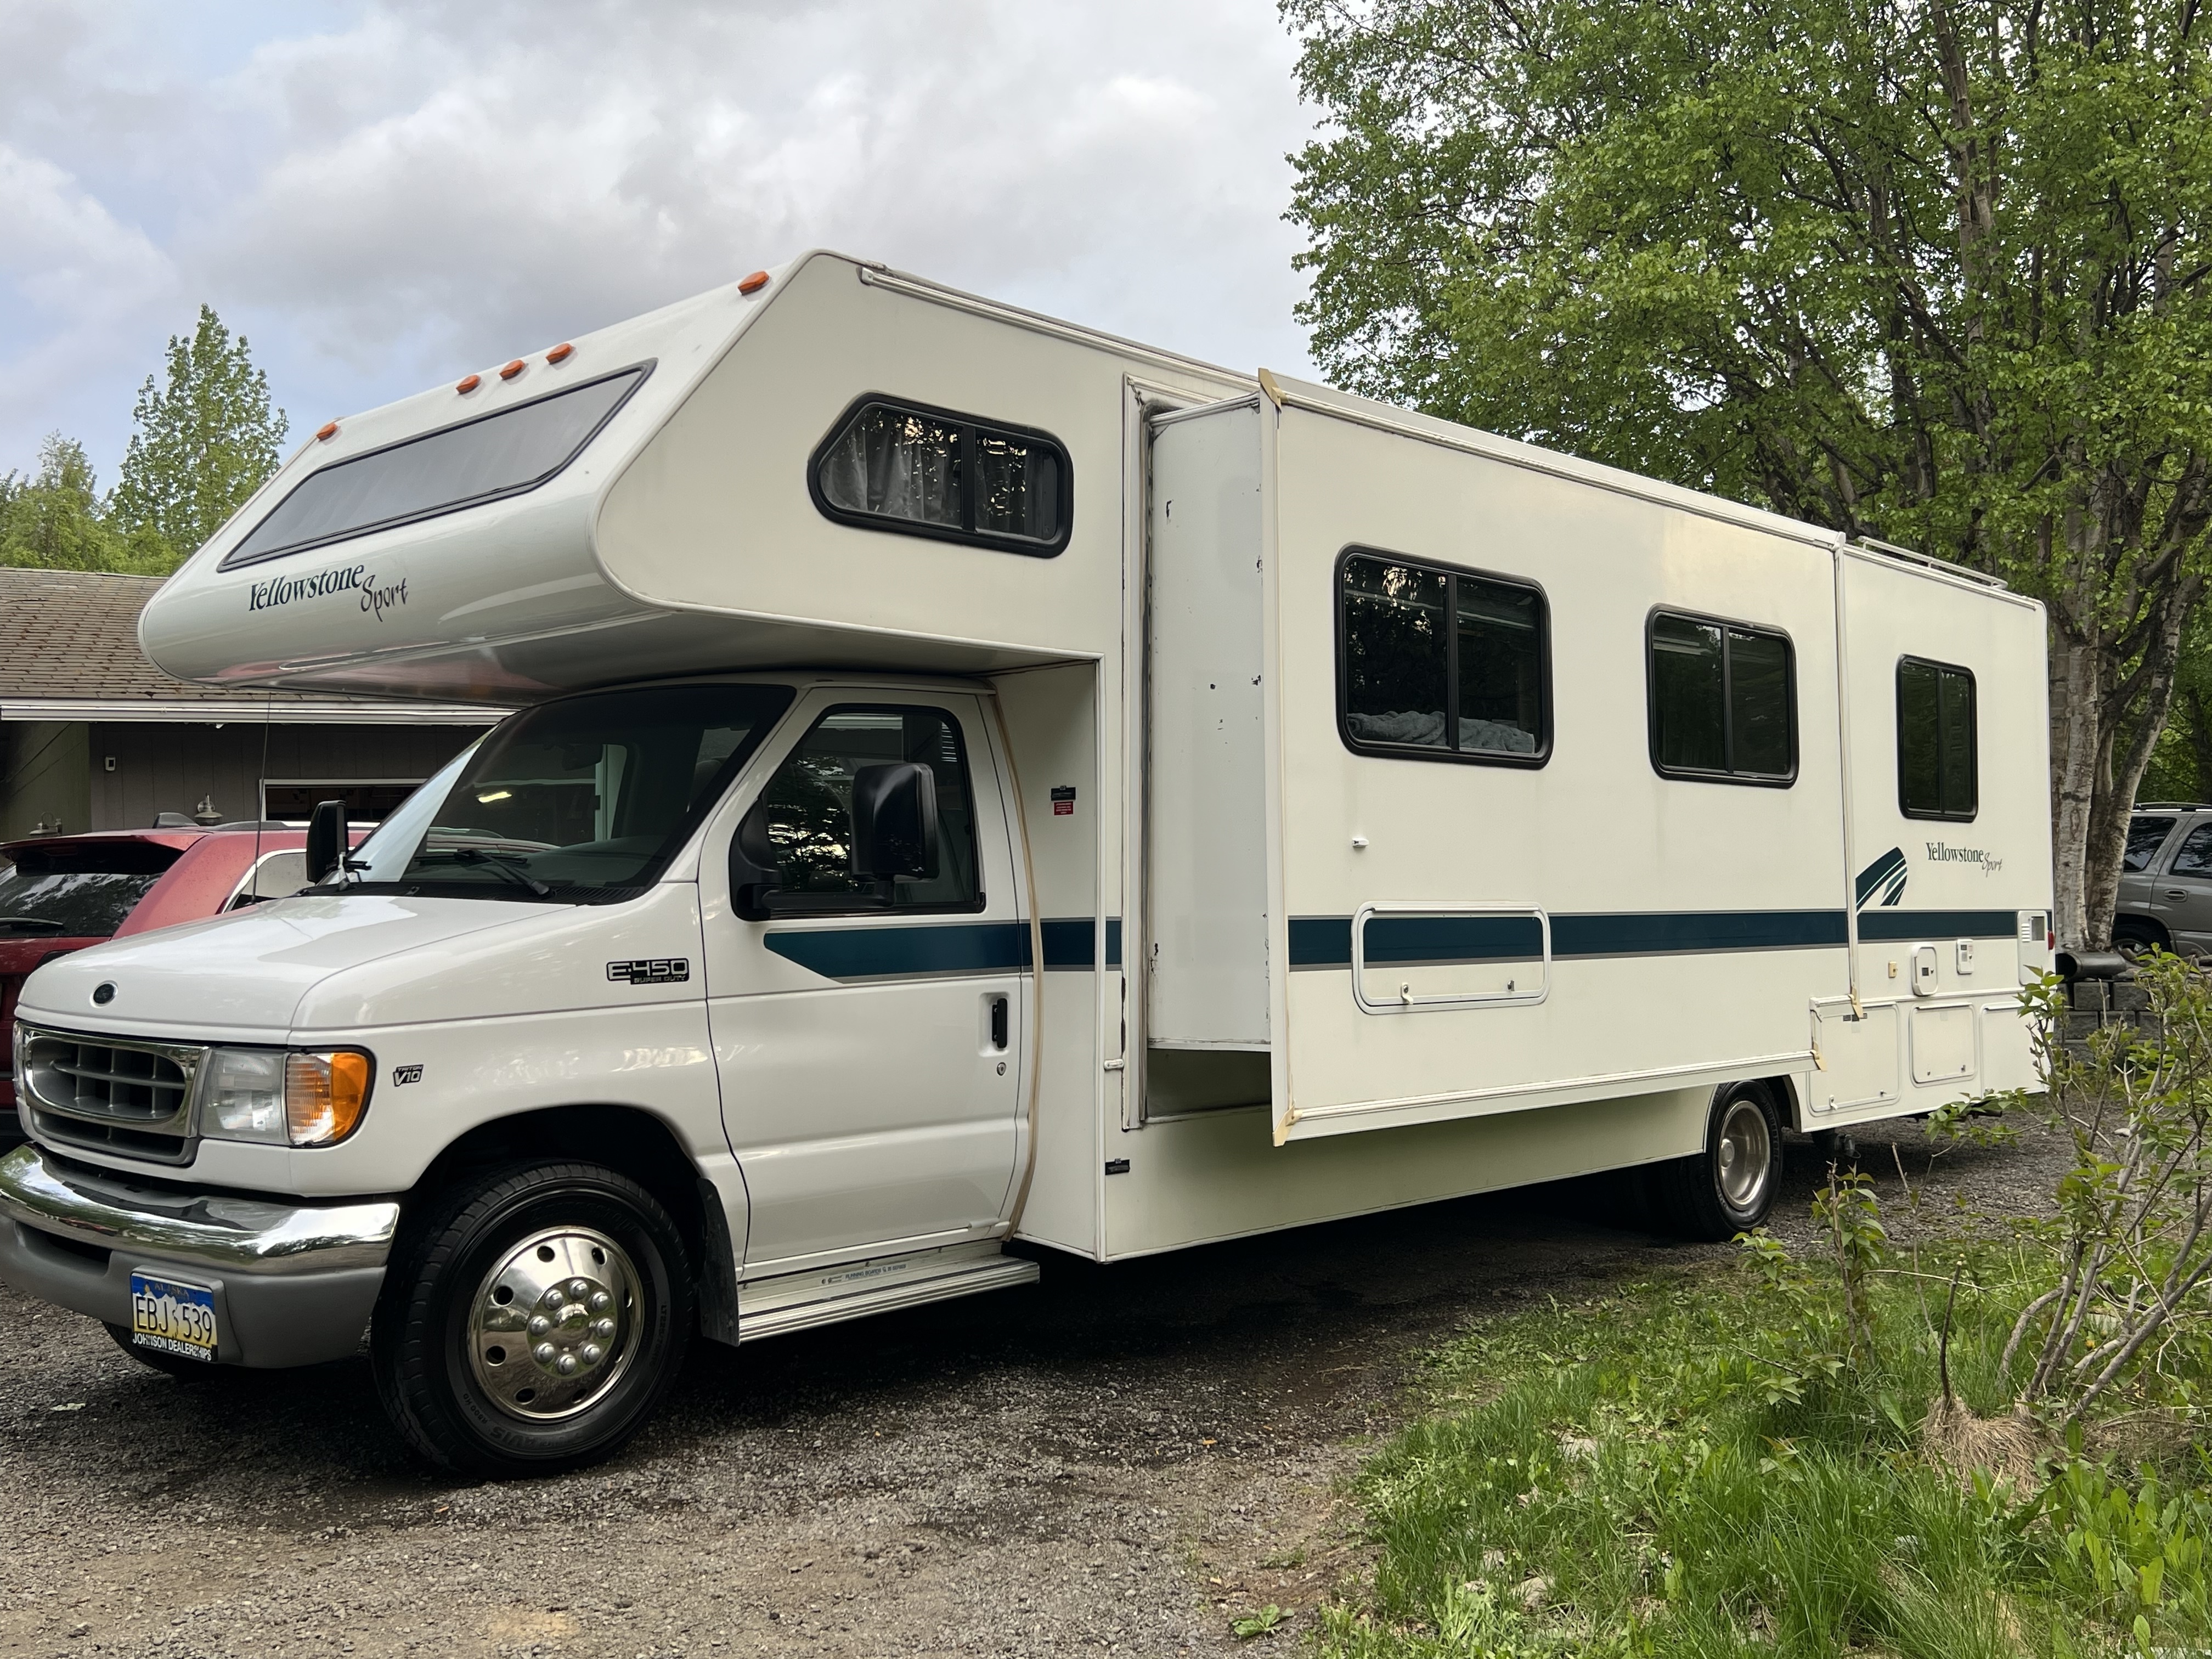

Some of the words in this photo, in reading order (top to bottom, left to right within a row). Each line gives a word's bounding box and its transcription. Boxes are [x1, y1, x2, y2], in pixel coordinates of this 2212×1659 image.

[249, 565, 364, 611] Yellowstone
[360, 574, 409, 623] Sport
[1926, 842, 1984, 862] Yellowstone
[1982, 852, 2003, 878] Sport
[394, 1071, 421, 1085] V10
[155, 1283, 190, 1297] ALSKA
[136, 1296, 168, 1331] EBJ
[183, 1305, 213, 1344] 539
